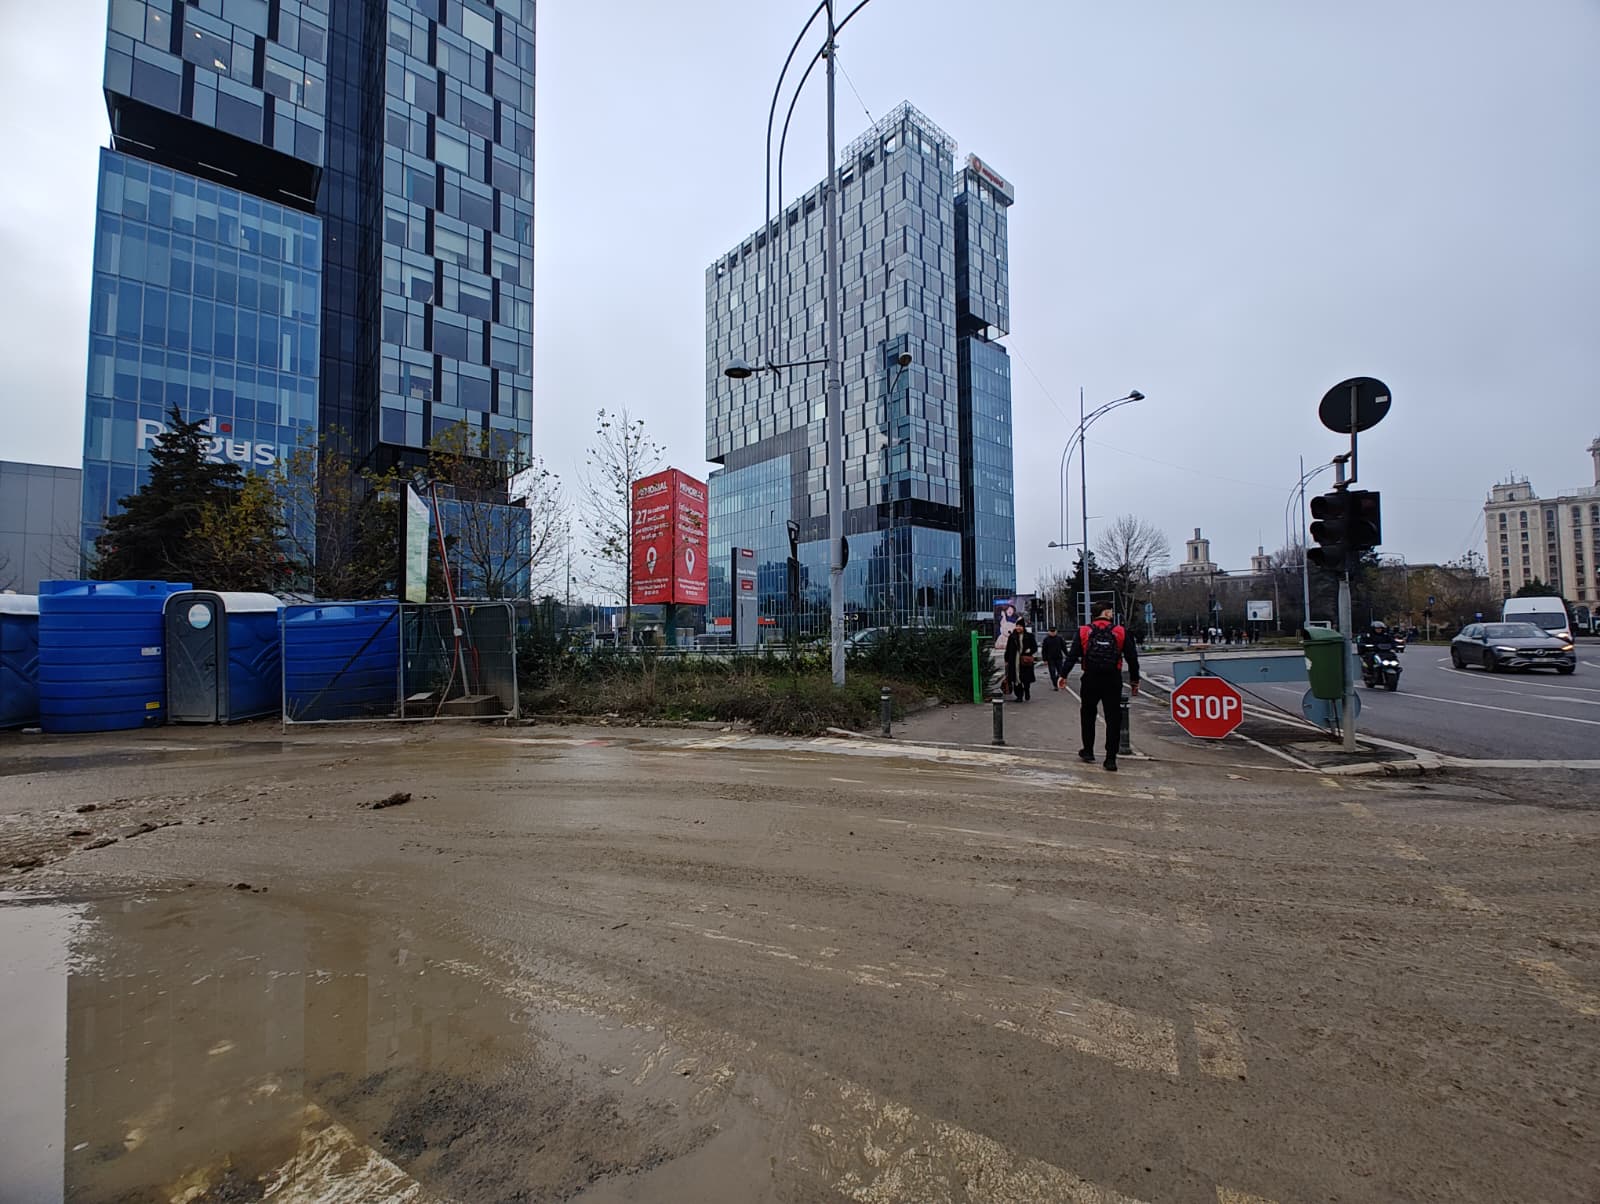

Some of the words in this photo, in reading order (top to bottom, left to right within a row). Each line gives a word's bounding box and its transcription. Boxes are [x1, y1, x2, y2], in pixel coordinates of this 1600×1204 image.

[137, 418, 275, 467] Rgus
[635, 510, 647, 525] 27
[1175, 695, 1238, 720] STOP
